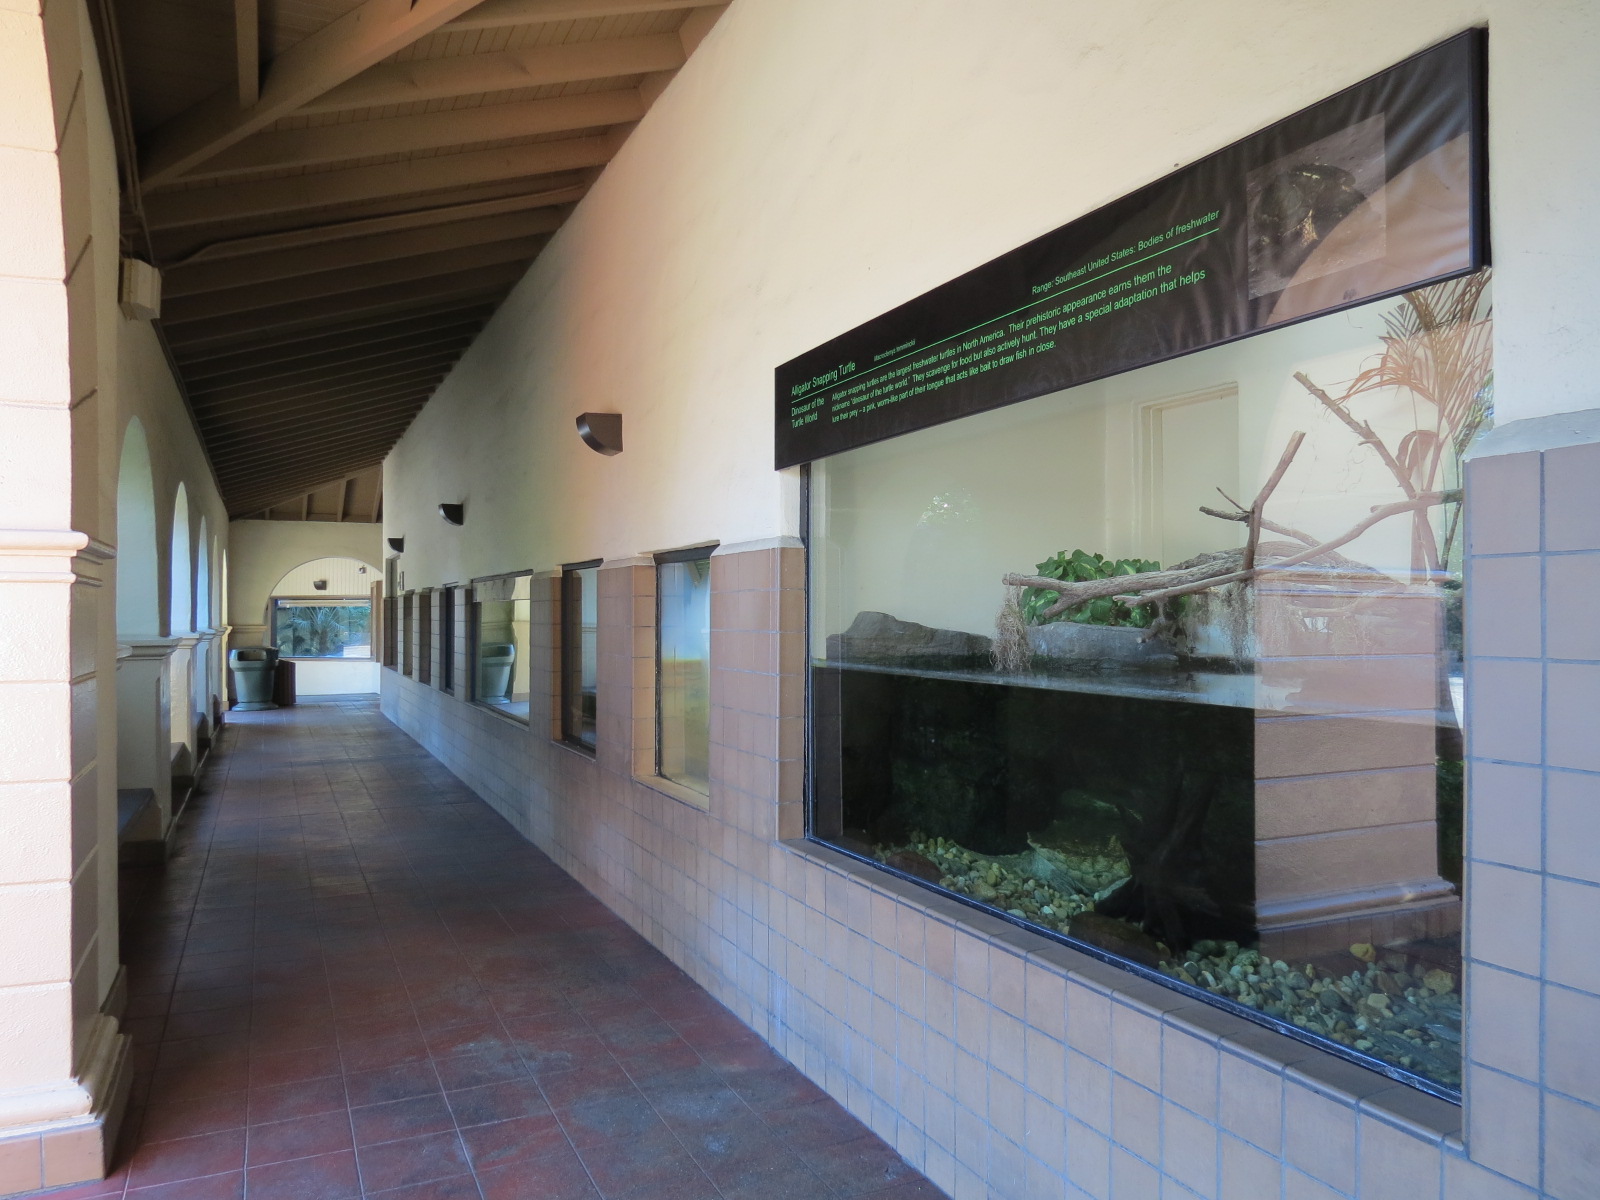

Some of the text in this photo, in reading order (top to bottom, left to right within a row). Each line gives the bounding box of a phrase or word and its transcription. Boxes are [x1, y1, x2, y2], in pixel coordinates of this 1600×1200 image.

[1032, 210, 1219, 295] Range: Southeast United States: Bodies of freshwater
[832, 390, 847, 401] Alligator
[848, 383, 866, 394] snapping
[867, 377, 879, 387] turtles
[880, 374, 888, 383] are
[896, 363, 912, 376] largest
[912, 354, 939, 370] freshwater
[940, 348, 955, 360] turtles
[963, 338, 979, 351] North
[979, 329, 1006, 345] America.
[1008, 320, 1025, 333] Their
[1026, 306, 1061, 329] prehistoric
[1062, 289, 1107, 313] appearance
[1108, 280, 1132, 295] earns
[1134, 271, 1155, 286] them
[1157, 265, 1172, 277] the
[832, 401, 850, 412] nickname
[883, 383, 894, 394] turtle
[912, 373, 925, 383] They
[926, 364, 951, 378] scavenge
[960, 354, 973, 366] food
[973, 352, 983, 361] but
[983, 347, 996, 358] also
[997, 337, 1020, 352] actively
[1021, 330, 1038, 343] hunt.
[1039, 324, 1057, 337] They
[1058, 317, 1076, 330] have
[1077, 314, 1083, 323] a
[1084, 301, 1112, 322] special
[1113, 287, 1158, 310] adaptation
[1160, 278, 1177, 293] that
[1180, 270, 1206, 286] helps
[791, 361, 856, 396] Alligator Snapping Turtle
[899, 391, 909, 402] part
[915, 384, 926, 395] their
[927, 379, 944, 391] tongue
[945, 374, 956, 384] that
[956, 370, 968, 380] acts
[969, 366, 979, 376] like
[979, 360, 991, 373] bait
[992, 360, 998, 369] to
[999, 354, 1015, 366] draw
[1015, 348, 1027, 360] fish
[1028, 346, 1035, 356] in
[1036, 340, 1056, 353] close.
[791, 403, 811, 417] Dinosaur
[791, 417, 804, 428] Turtle
